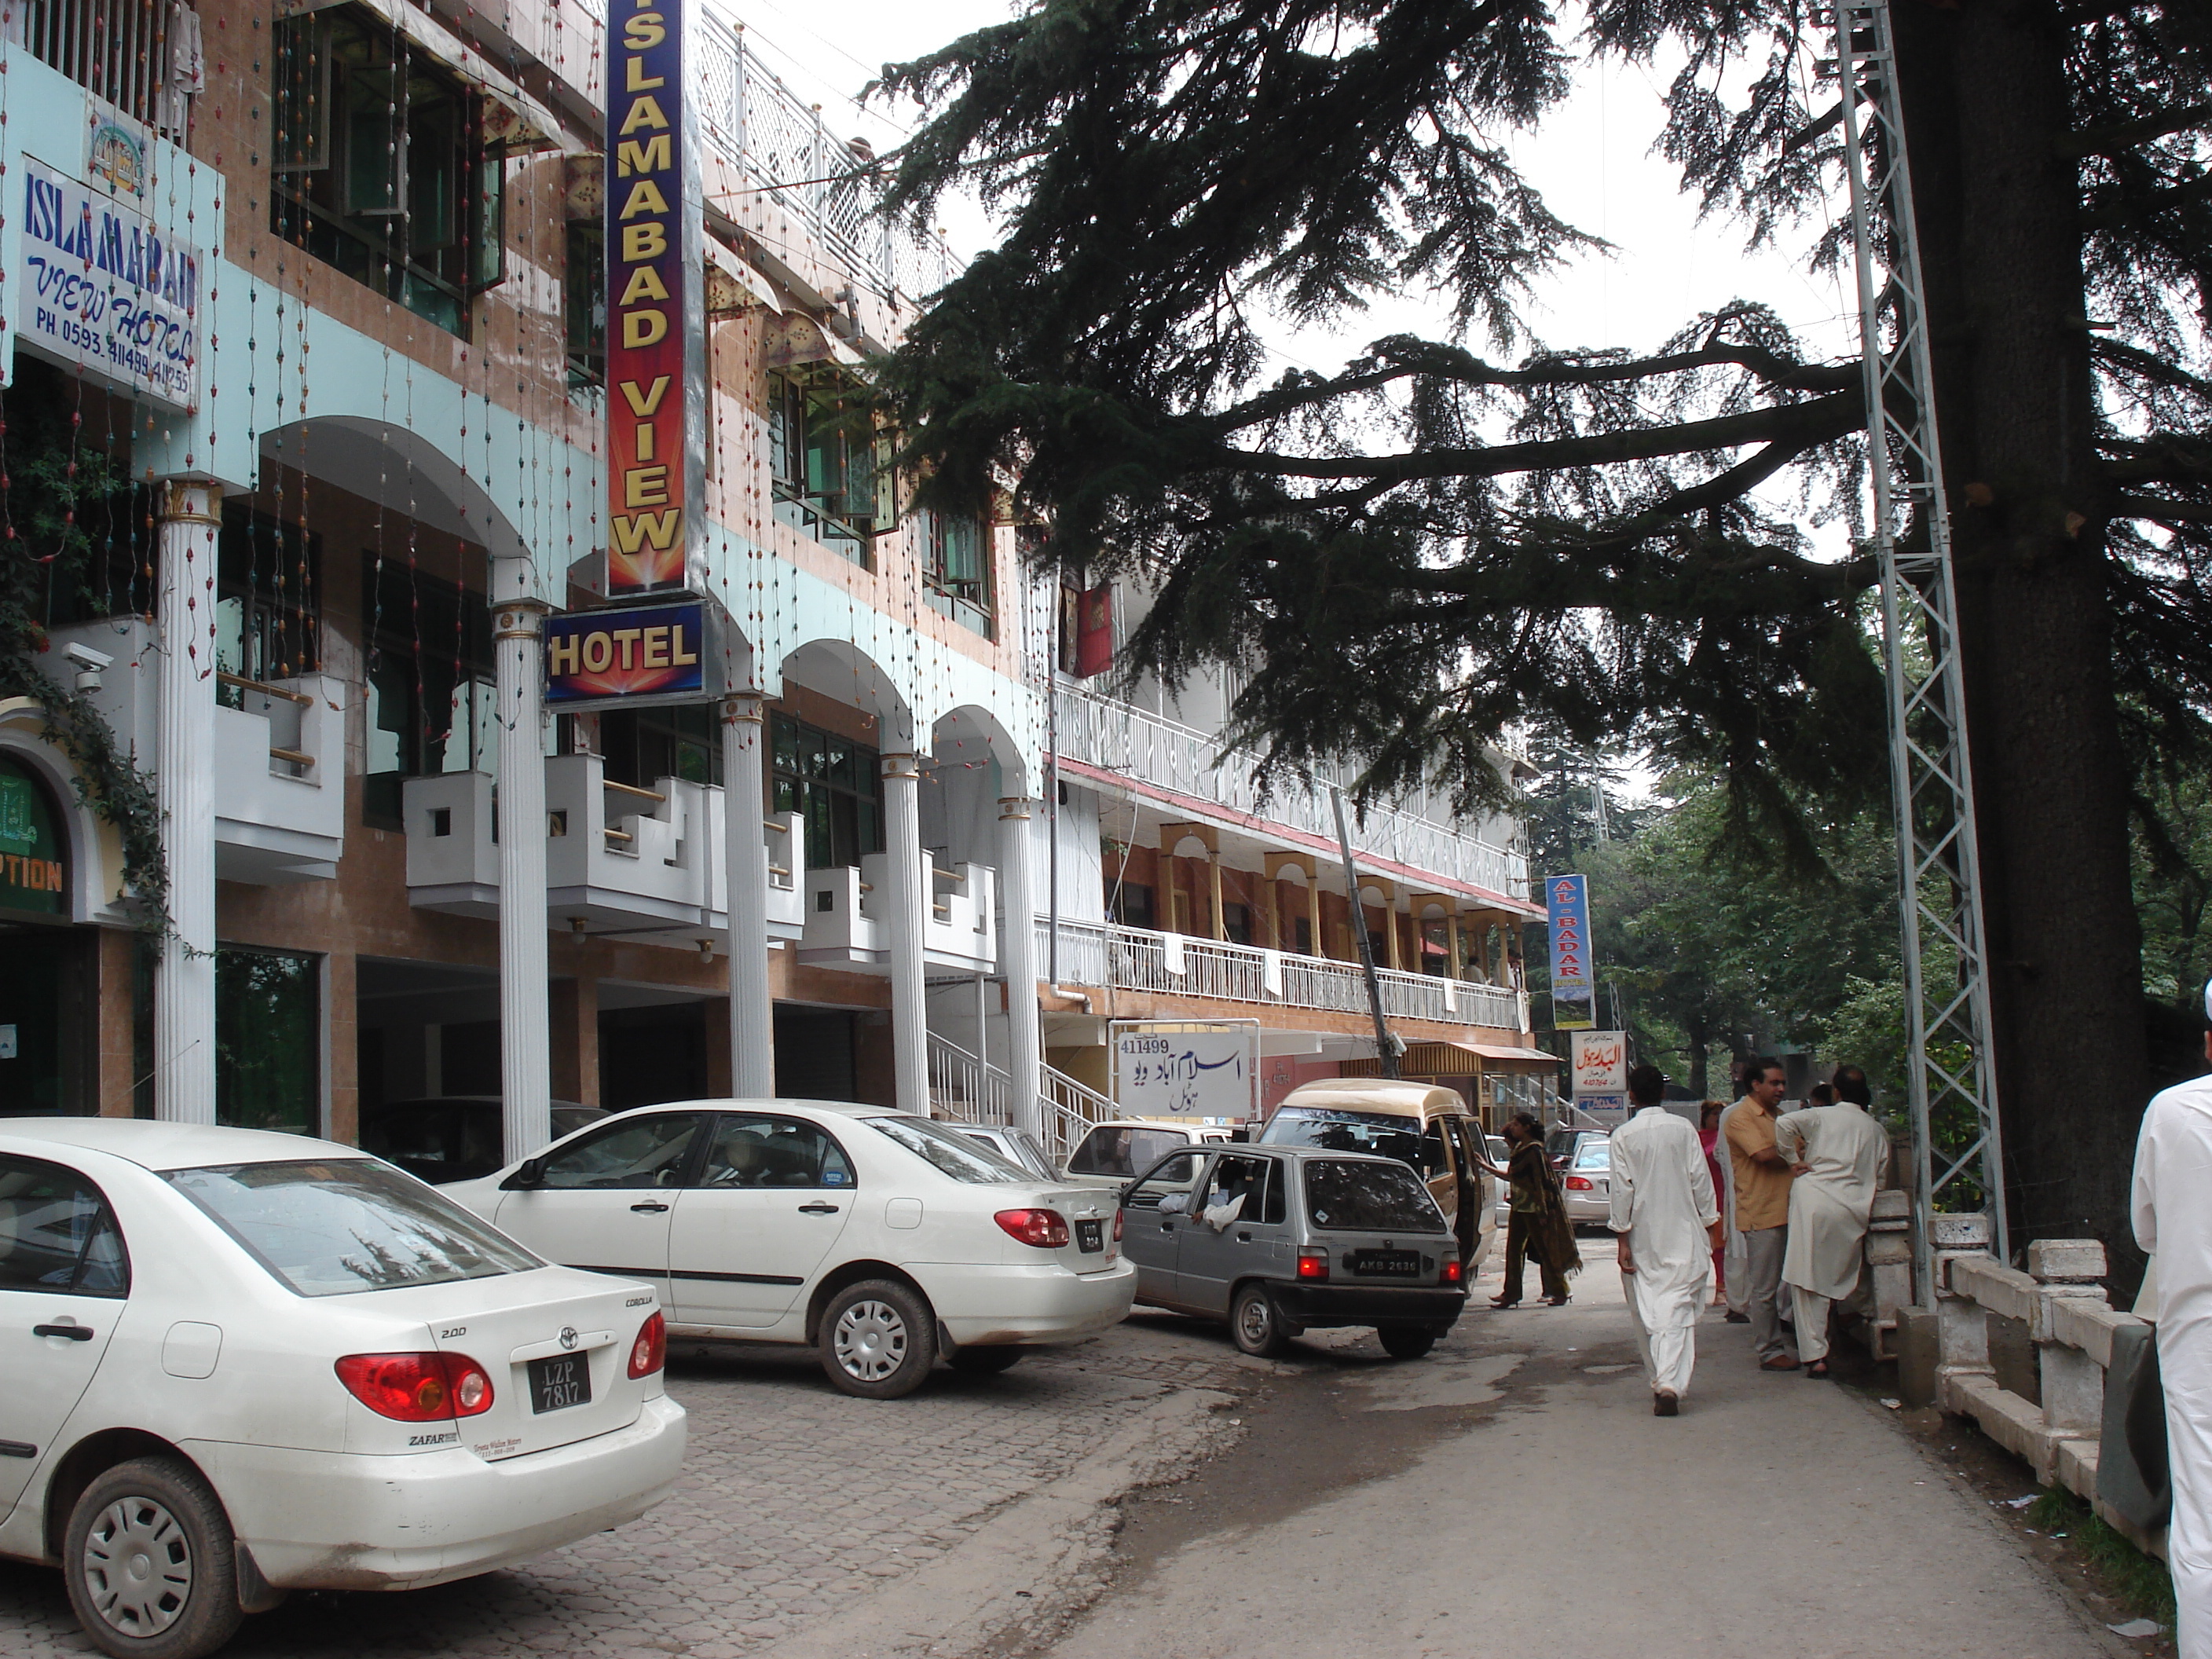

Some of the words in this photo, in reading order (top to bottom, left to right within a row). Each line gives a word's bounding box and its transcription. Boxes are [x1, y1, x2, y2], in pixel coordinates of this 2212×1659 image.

[618, 0, 671, 350] SLAMABAD
[28, 255, 106, 323] VIEW
[112, 298, 192, 361] HOTEL
[613, 375, 680, 555] VIEW
[551, 624, 698, 676] HOTEL
[0, 854, 62, 892] TION
[1554, 978, 1588, 987] HOTEL
[1120, 1039, 1170, 1054] 411499
[1177, 1049, 1241, 1082] اسلام
[626, 1296, 653, 1307] COROLLA
[544, 1361, 573, 1386] LZP
[542, 1381, 579, 1408] 7817
[408, 1434, 445, 1446] ZAFAR
